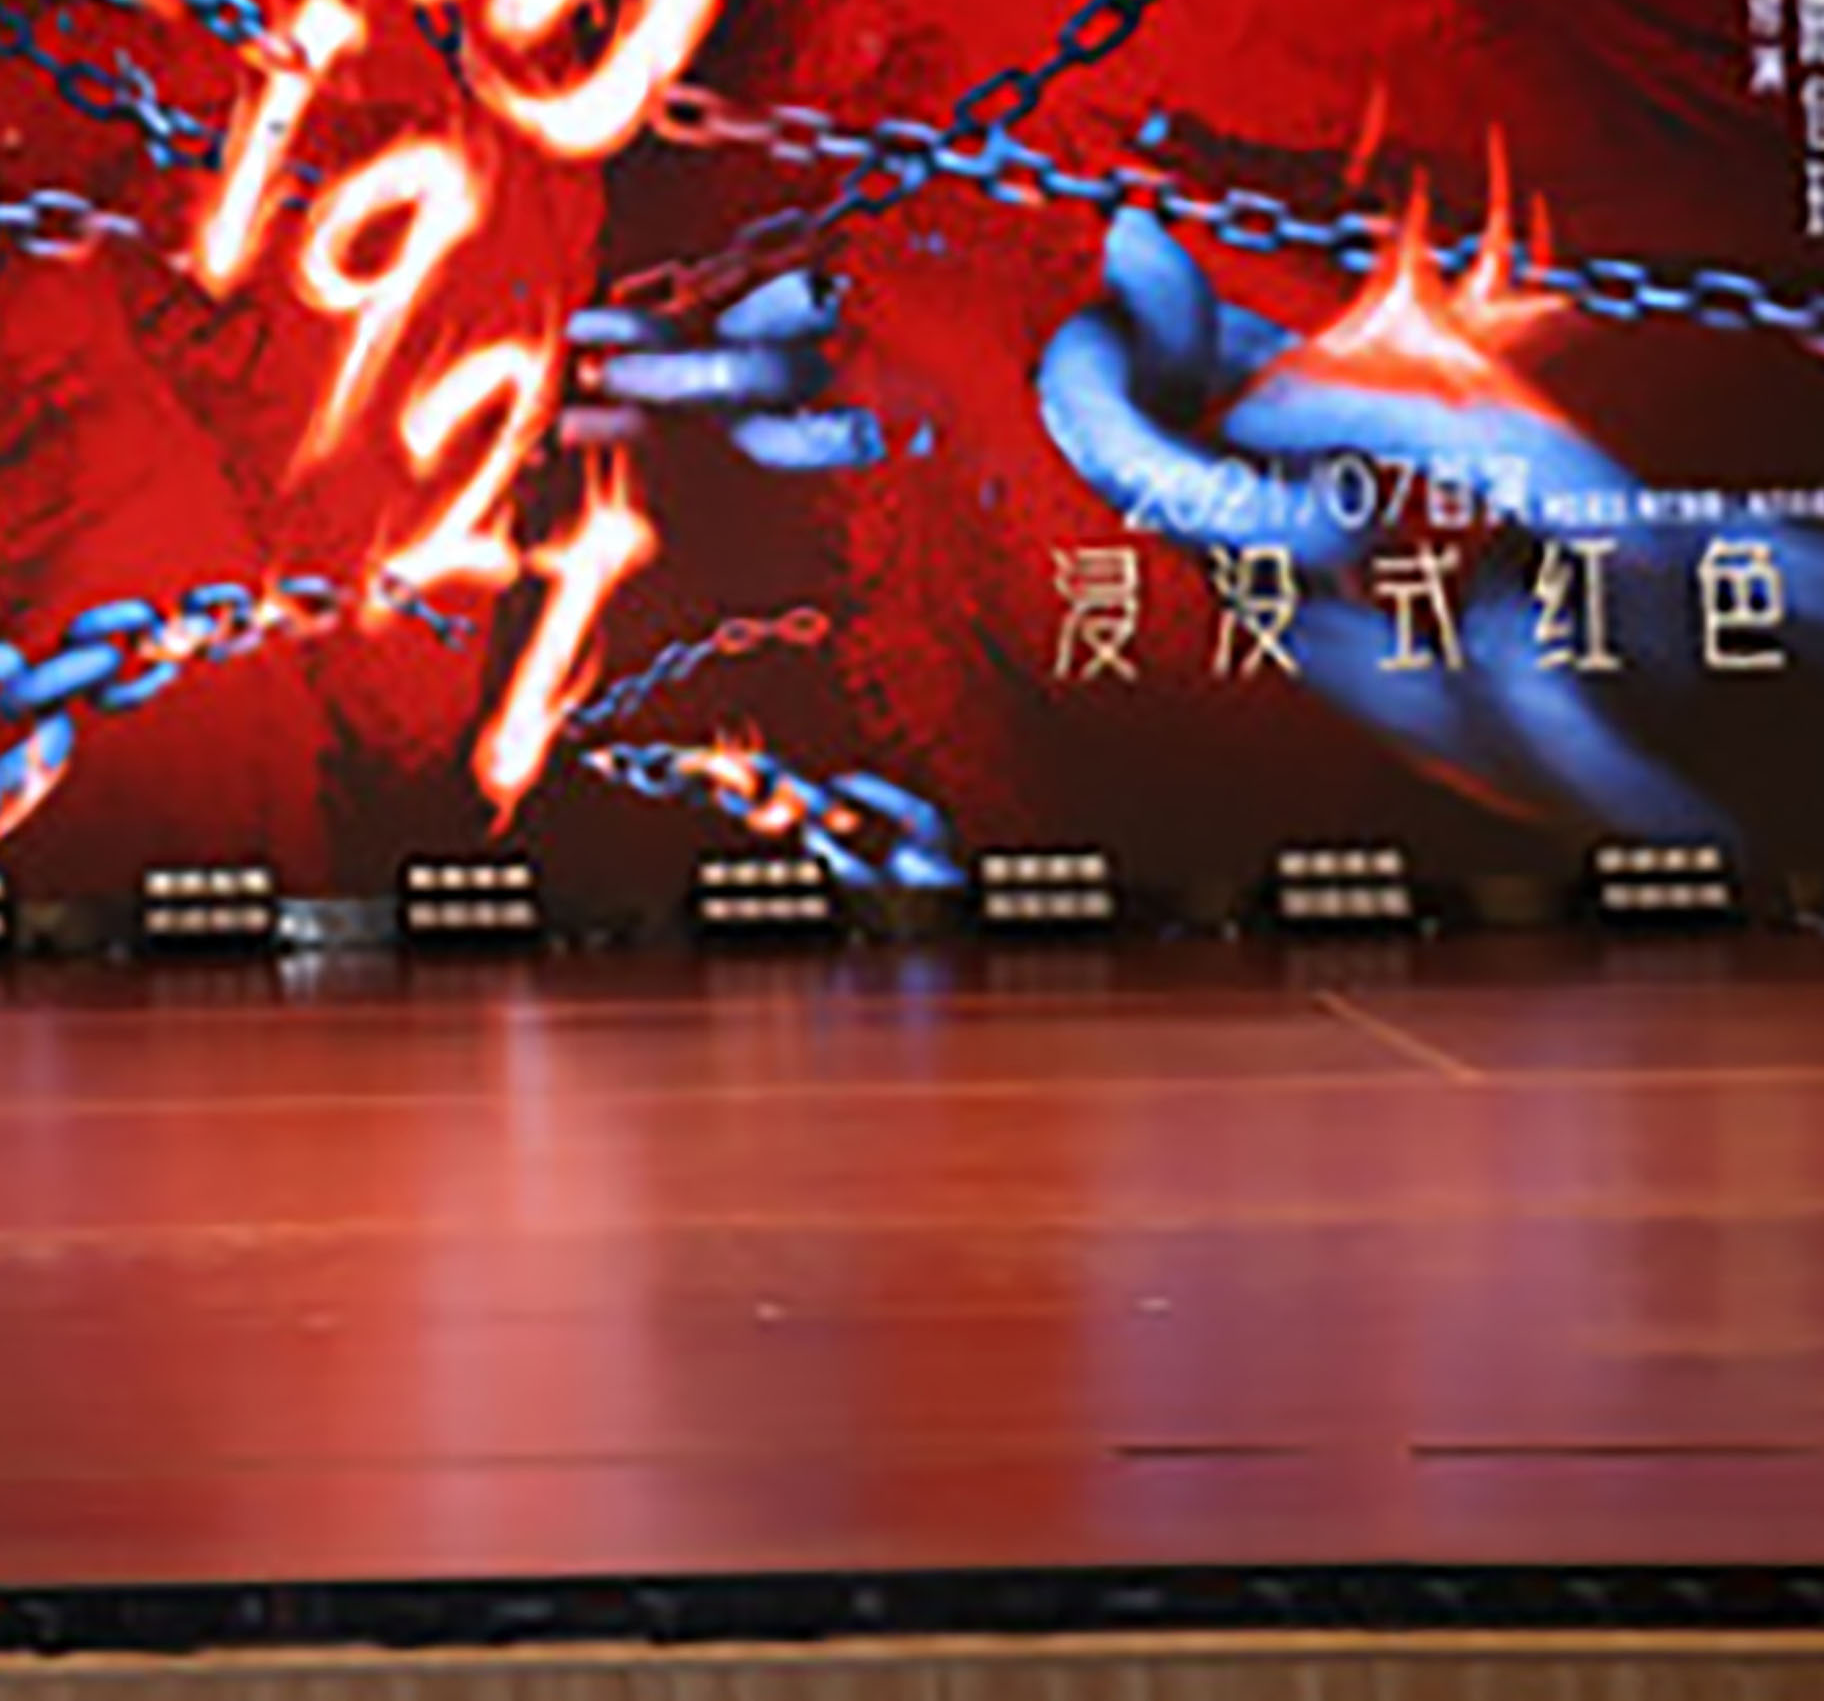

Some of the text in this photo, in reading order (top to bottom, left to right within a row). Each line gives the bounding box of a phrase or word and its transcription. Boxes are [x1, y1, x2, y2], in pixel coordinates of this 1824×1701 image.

[1050, 535, 1788, 679] 浸没式红色
